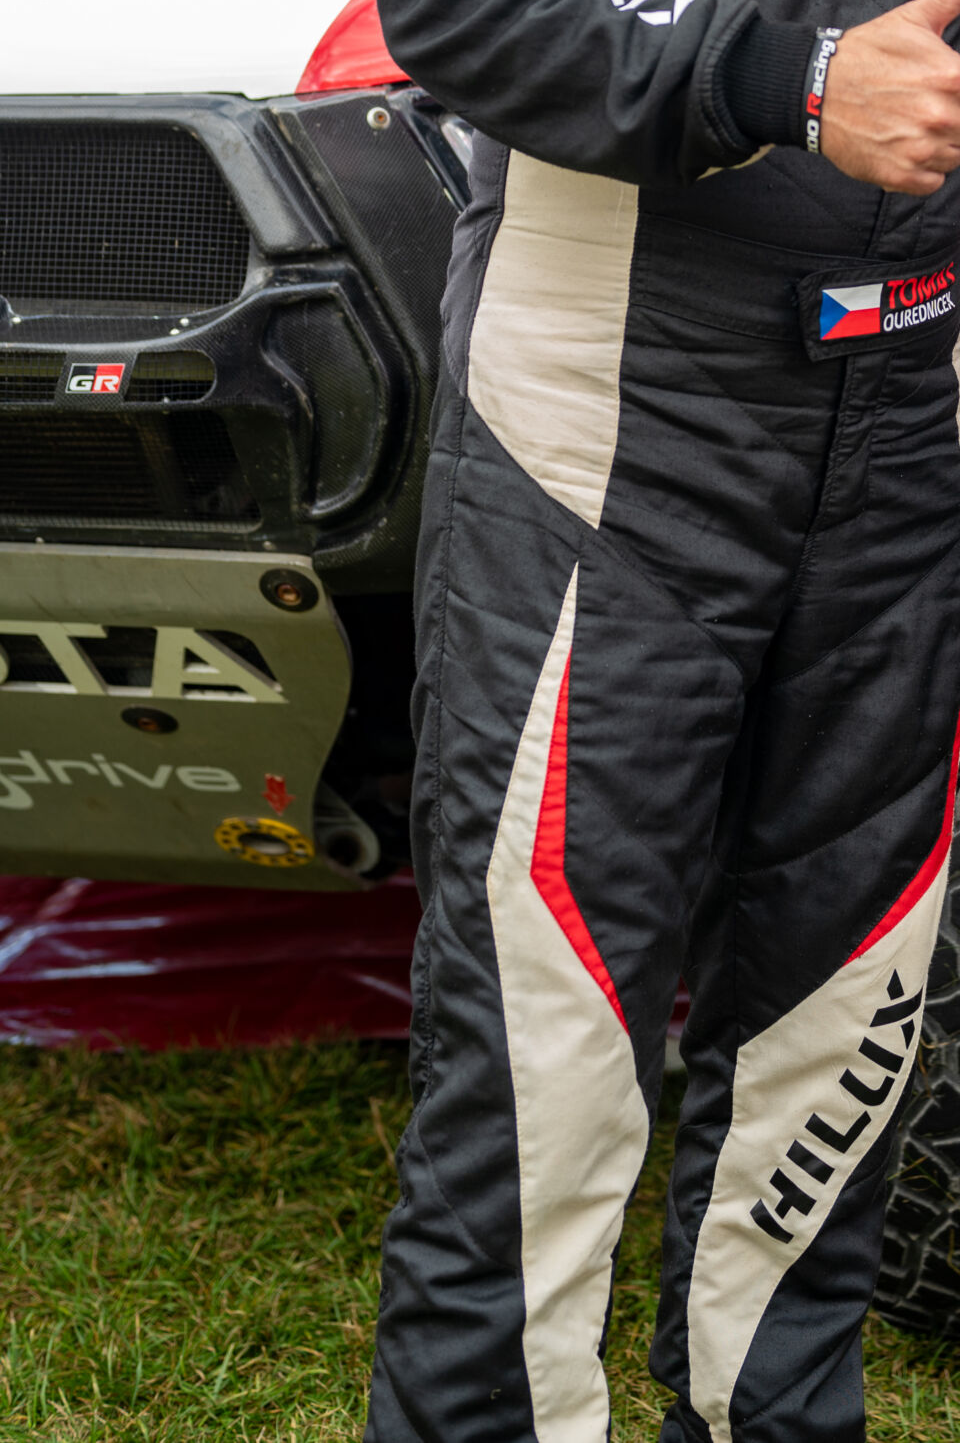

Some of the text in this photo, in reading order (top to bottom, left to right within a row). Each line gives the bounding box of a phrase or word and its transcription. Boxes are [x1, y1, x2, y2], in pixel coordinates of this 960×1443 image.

[805, 39, 837, 117] Racing
[886, 260, 956, 310] TOMAS
[883, 290, 957, 333] OUREDNICEK
[69, 374, 120, 392] GR
[749, 967, 924, 1245] HILUX
